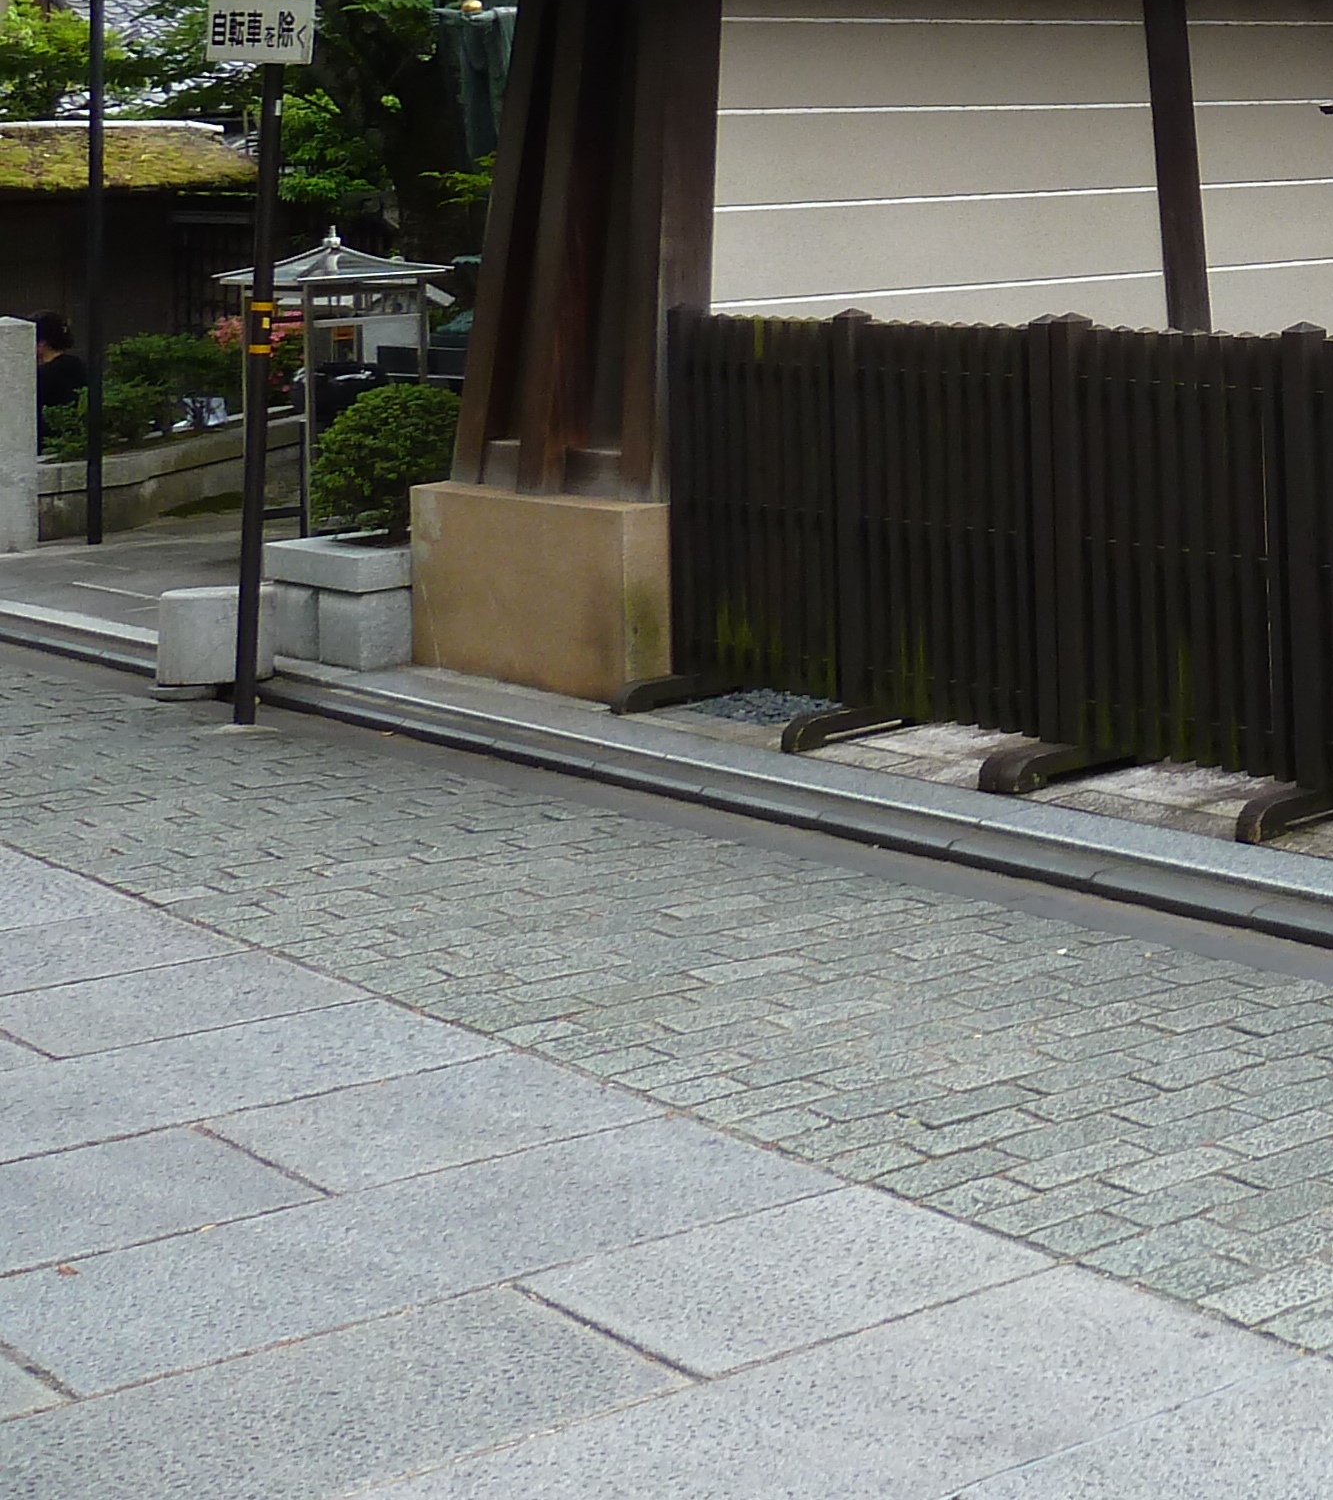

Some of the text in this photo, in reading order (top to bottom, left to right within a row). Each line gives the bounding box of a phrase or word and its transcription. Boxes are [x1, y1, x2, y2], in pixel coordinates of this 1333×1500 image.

[212, 10, 307, 49] 自転車を除く
